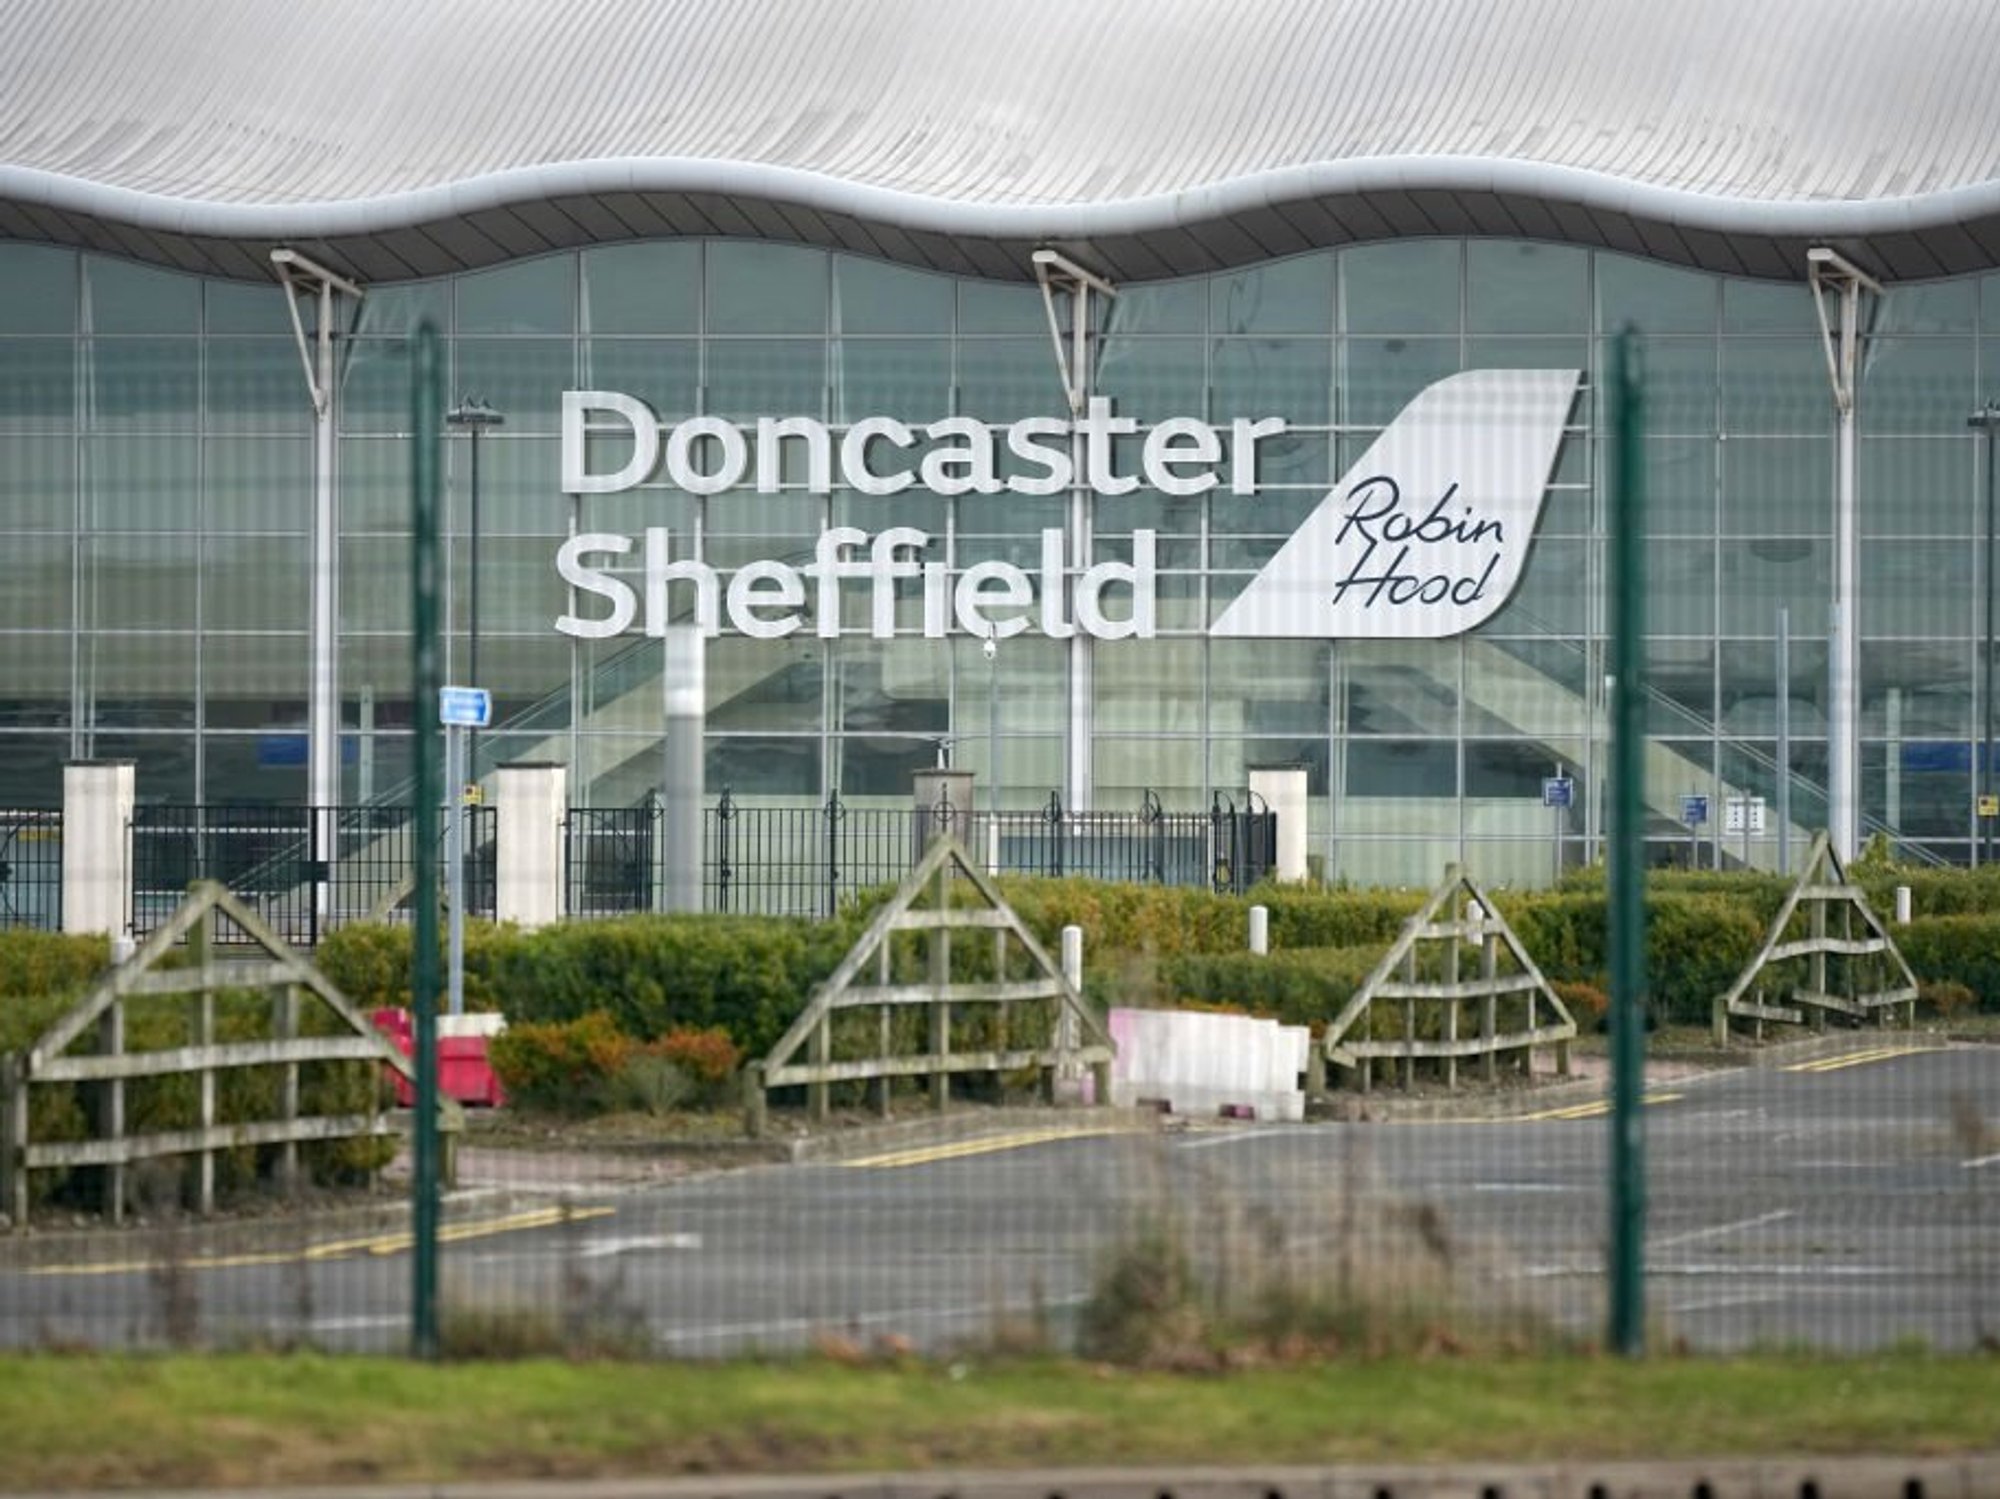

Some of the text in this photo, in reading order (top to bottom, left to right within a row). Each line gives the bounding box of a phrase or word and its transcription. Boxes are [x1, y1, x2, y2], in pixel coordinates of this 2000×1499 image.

[561, 391, 1286, 495] Doncaster
[1335, 476, 1504, 544] Robin
[555, 527, 1157, 640] Sheffield
[1333, 541, 1500, 607] Hood
